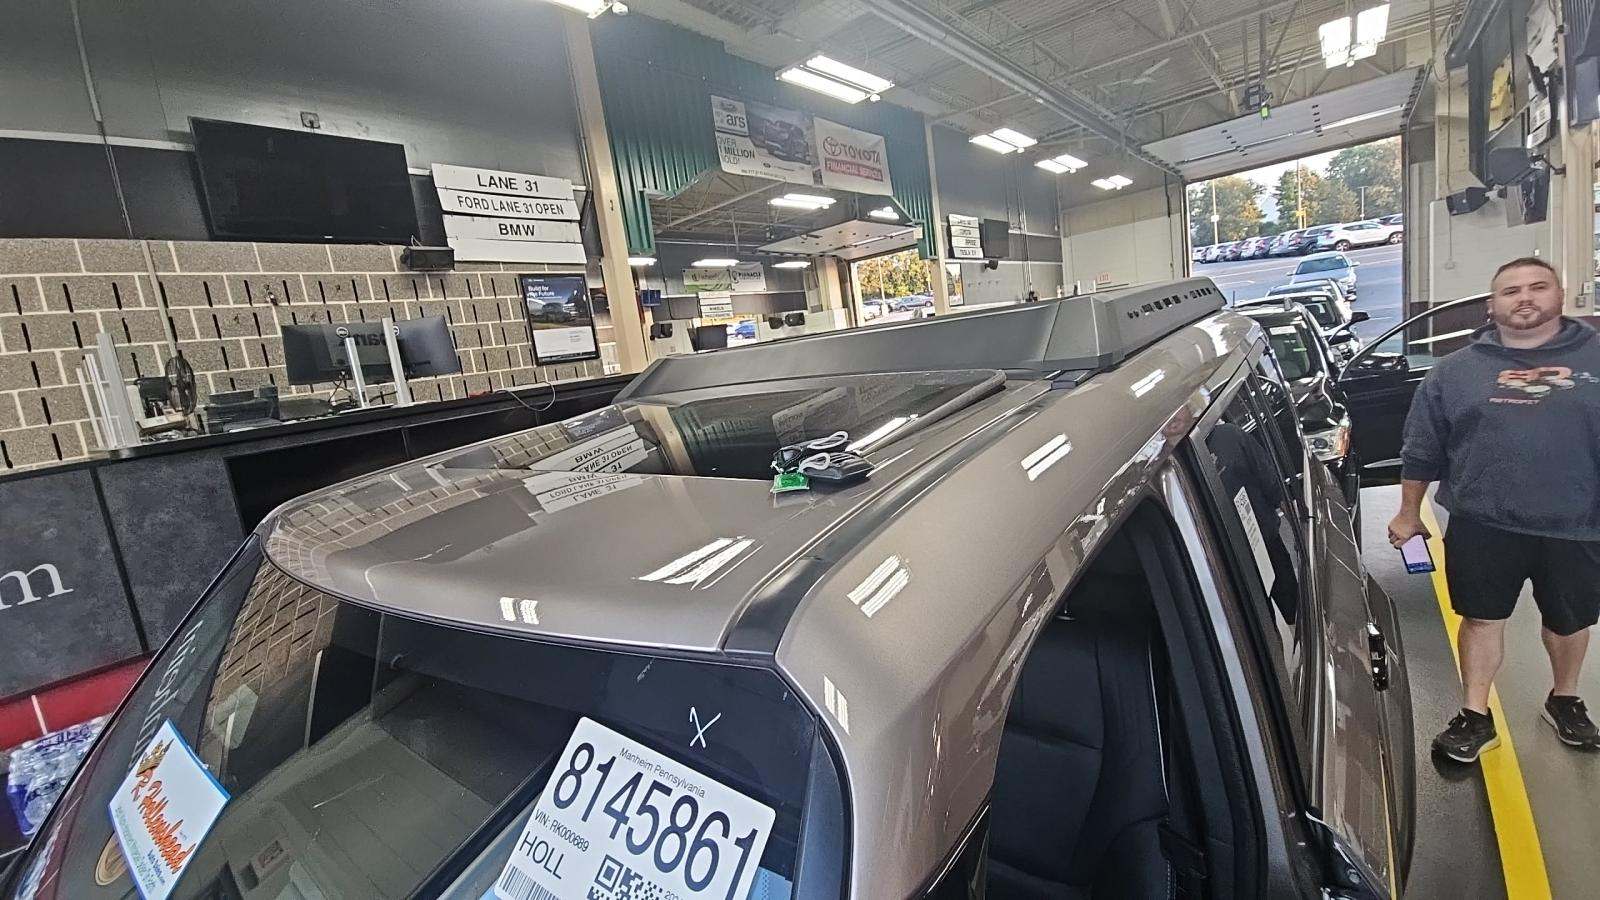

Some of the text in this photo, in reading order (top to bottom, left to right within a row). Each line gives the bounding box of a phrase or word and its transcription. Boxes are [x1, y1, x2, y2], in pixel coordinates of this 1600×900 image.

[841, 143, 881, 165] TOYOTA
[477, 174, 539, 192] LANE 31
[457, 195, 565, 215] FORD LANE 31 OPEN
[498, 223, 535, 236] BMW
[619, 747, 706, 799] Manheim Pennsylvania
[534, 808, 590, 853] VIN: RK000689
[552, 742, 758, 900] 8145861
[518, 830, 564, 880] HOLL
